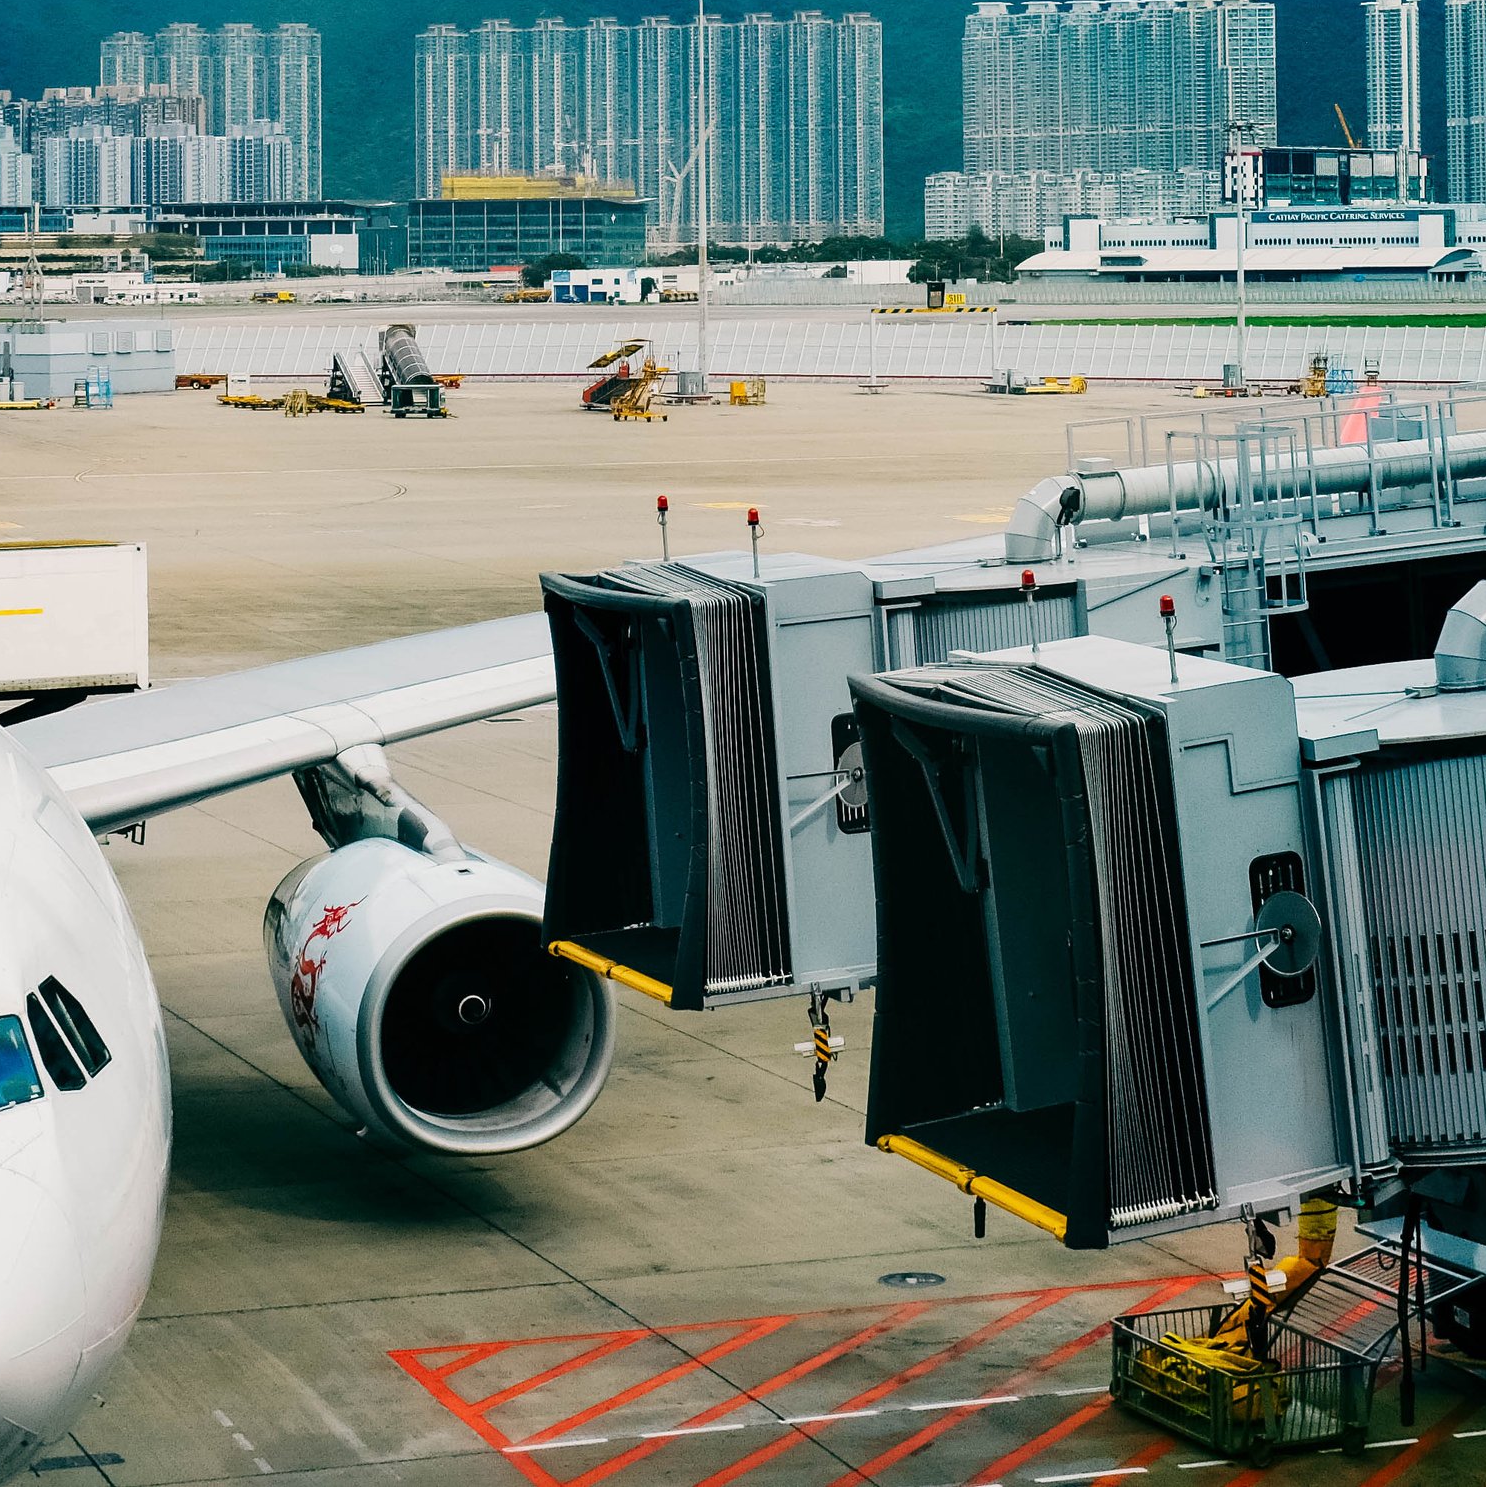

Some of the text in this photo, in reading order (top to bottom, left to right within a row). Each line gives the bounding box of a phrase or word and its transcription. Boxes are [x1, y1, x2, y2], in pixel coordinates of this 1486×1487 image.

[1268, 211, 1405, 221] CATHAY PACIFIC CATERING SERVICES
